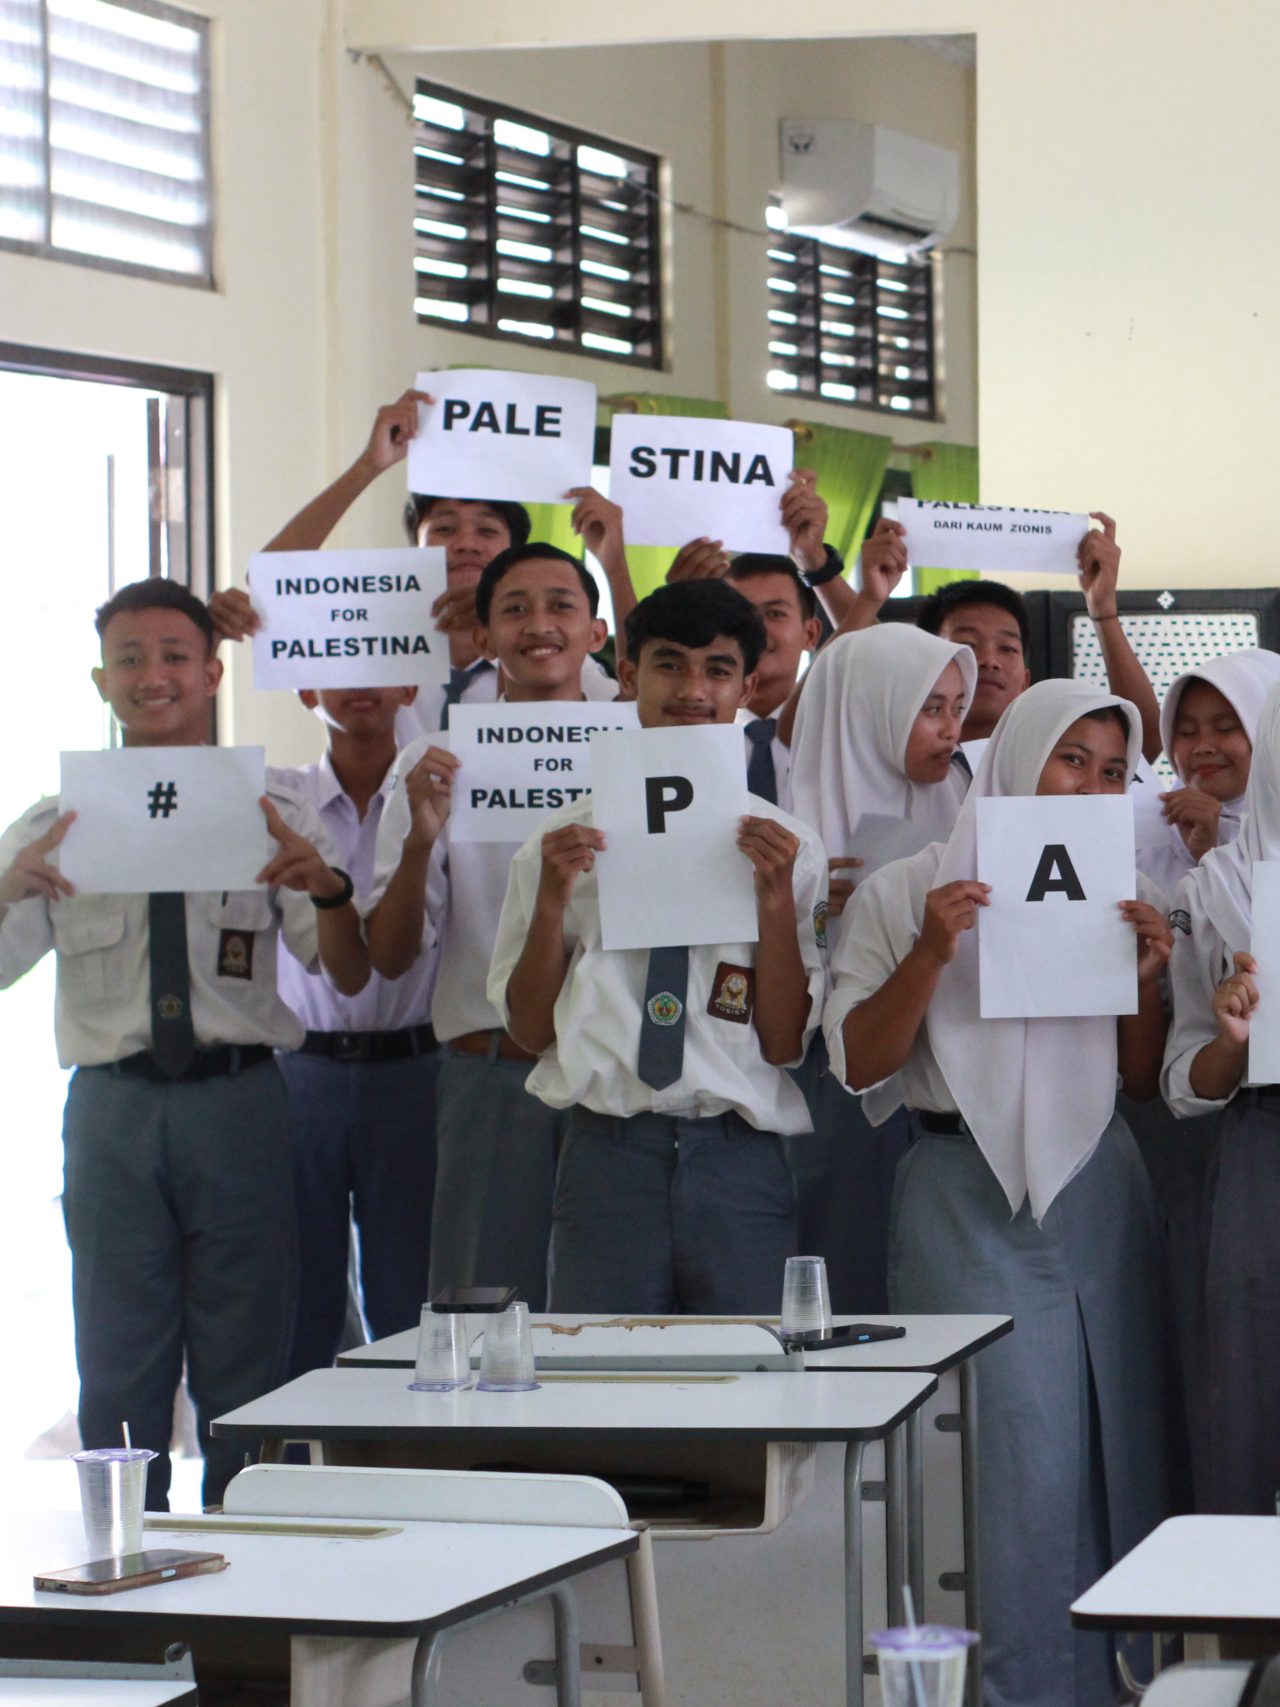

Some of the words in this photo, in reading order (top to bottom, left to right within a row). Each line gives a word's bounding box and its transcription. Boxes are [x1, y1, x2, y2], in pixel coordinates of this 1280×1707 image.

[443, 399, 563, 438] PALE
[629, 446, 776, 487] STINA
[933, 520, 962, 530] DARI
[966, 522, 1003, 532] KAUM
[1009, 523, 1053, 535] ZIONIS
[276, 575, 421, 595] INDONESIA
[331, 608, 369, 622] FOR
[271, 635, 431, 660] PALESTINA
[534, 758, 573, 771] FOR
[147, 782, 178, 819] #
[645, 776, 694, 835] P
[1026, 843, 1087, 903] A
